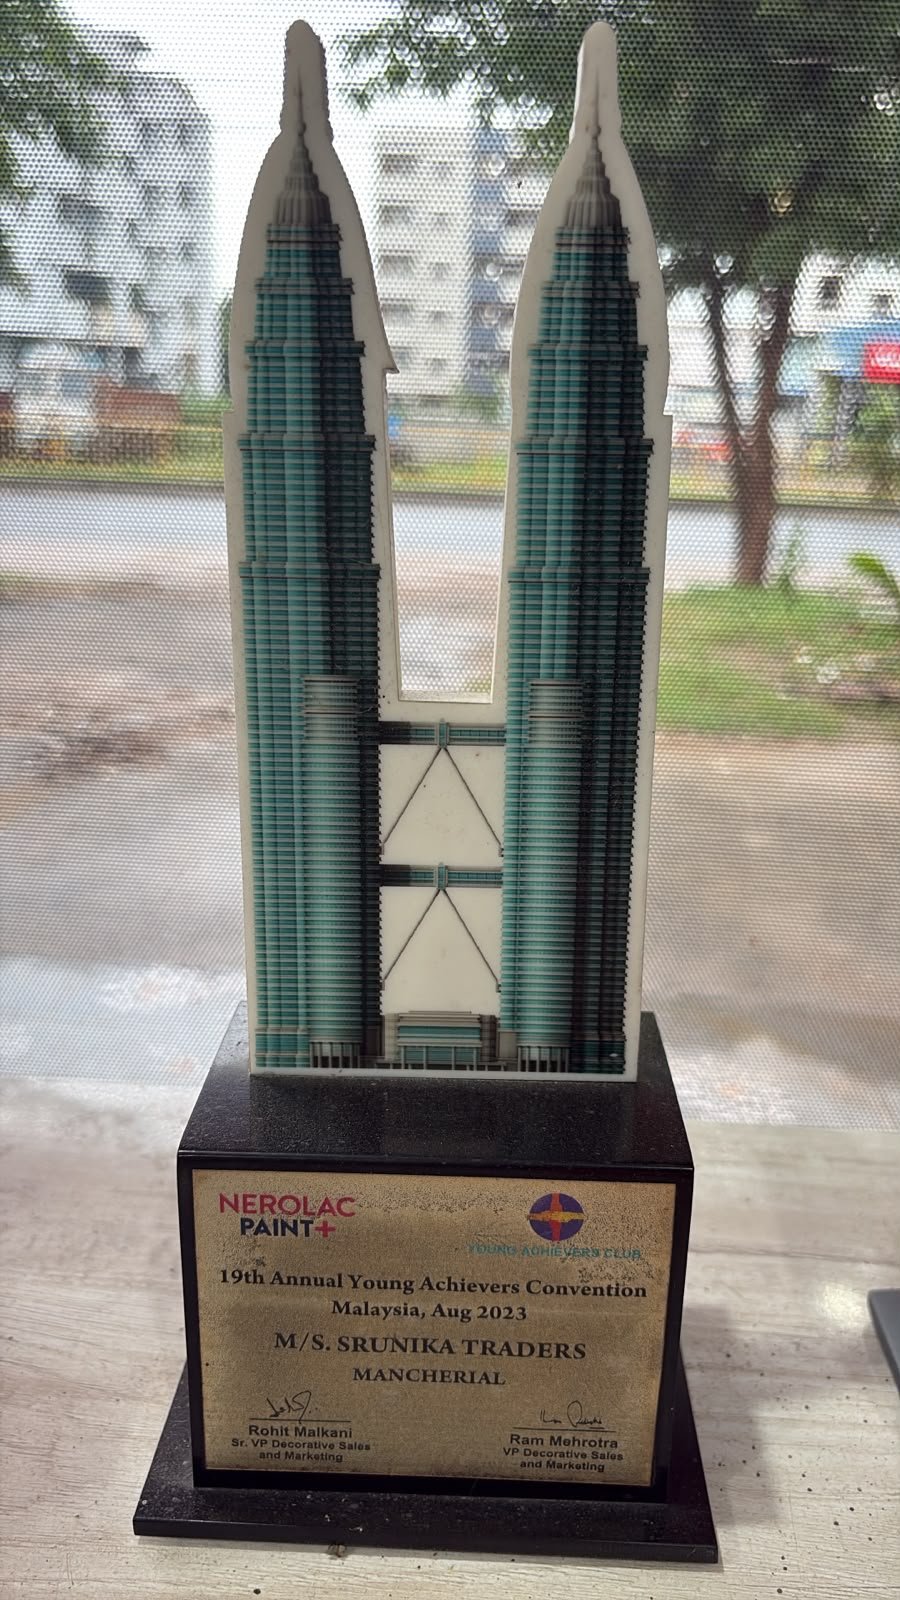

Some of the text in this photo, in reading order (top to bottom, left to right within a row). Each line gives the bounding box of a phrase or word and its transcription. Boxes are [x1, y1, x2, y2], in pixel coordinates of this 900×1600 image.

[219, 1193, 356, 1217] NEROLAC
[469, 1244, 641, 1259] YOUNG ACHIEVERS CLUB
[220, 1269, 647, 1298] 19th Annual Young Achievers Convention
[331, 1300, 527, 1323] Malaysia, Aug 2023
[274, 1332, 586, 1360] M/S. SRUNIKA TRADERS
[353, 1367, 506, 1386] MANCHERIAL
[249, 1424, 352, 1439] Rohit Malkani
[231, 1438, 371, 1451] Sr. VP Decorative Sales
[510, 1433, 618, 1449] Ram Mehrotra
[259, 1451, 344, 1464] and Marketing
[503, 1447, 624, 1461] VP Decorative Sales
[520, 1460, 605, 1473] and Marketing
